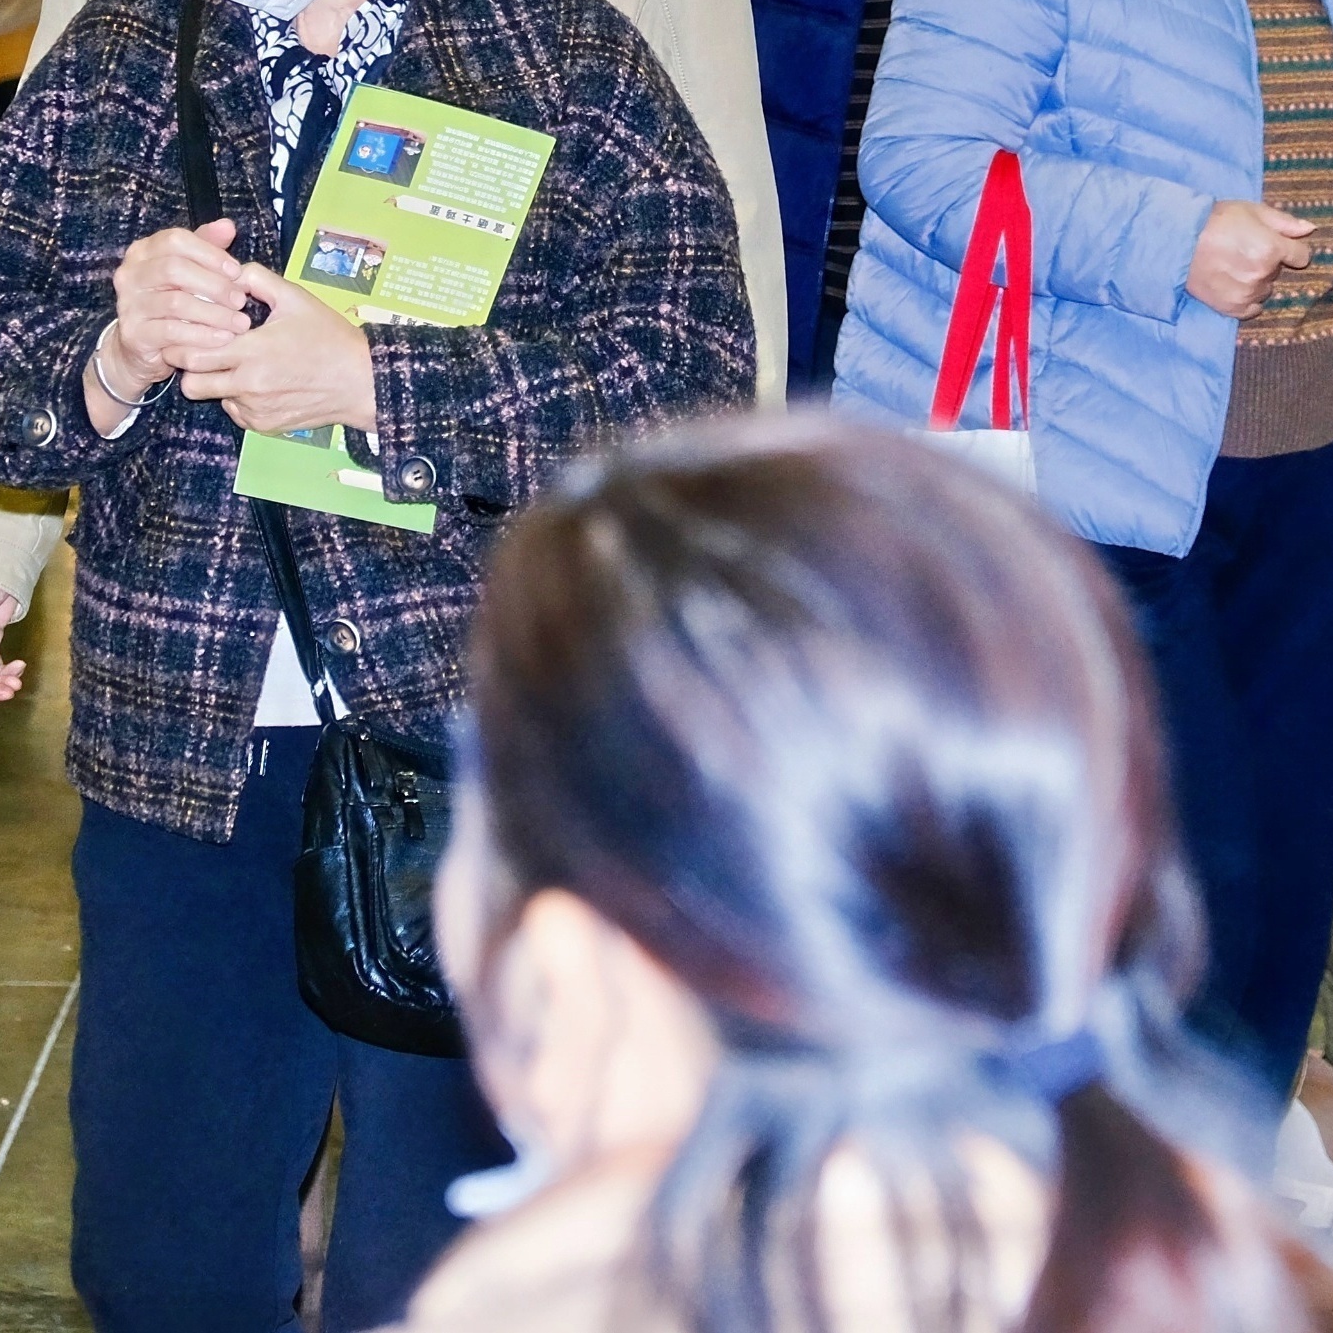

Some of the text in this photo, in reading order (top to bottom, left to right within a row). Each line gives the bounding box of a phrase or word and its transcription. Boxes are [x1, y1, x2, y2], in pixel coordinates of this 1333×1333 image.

[430, 205, 505, 234] 富硒土鸡蛋
